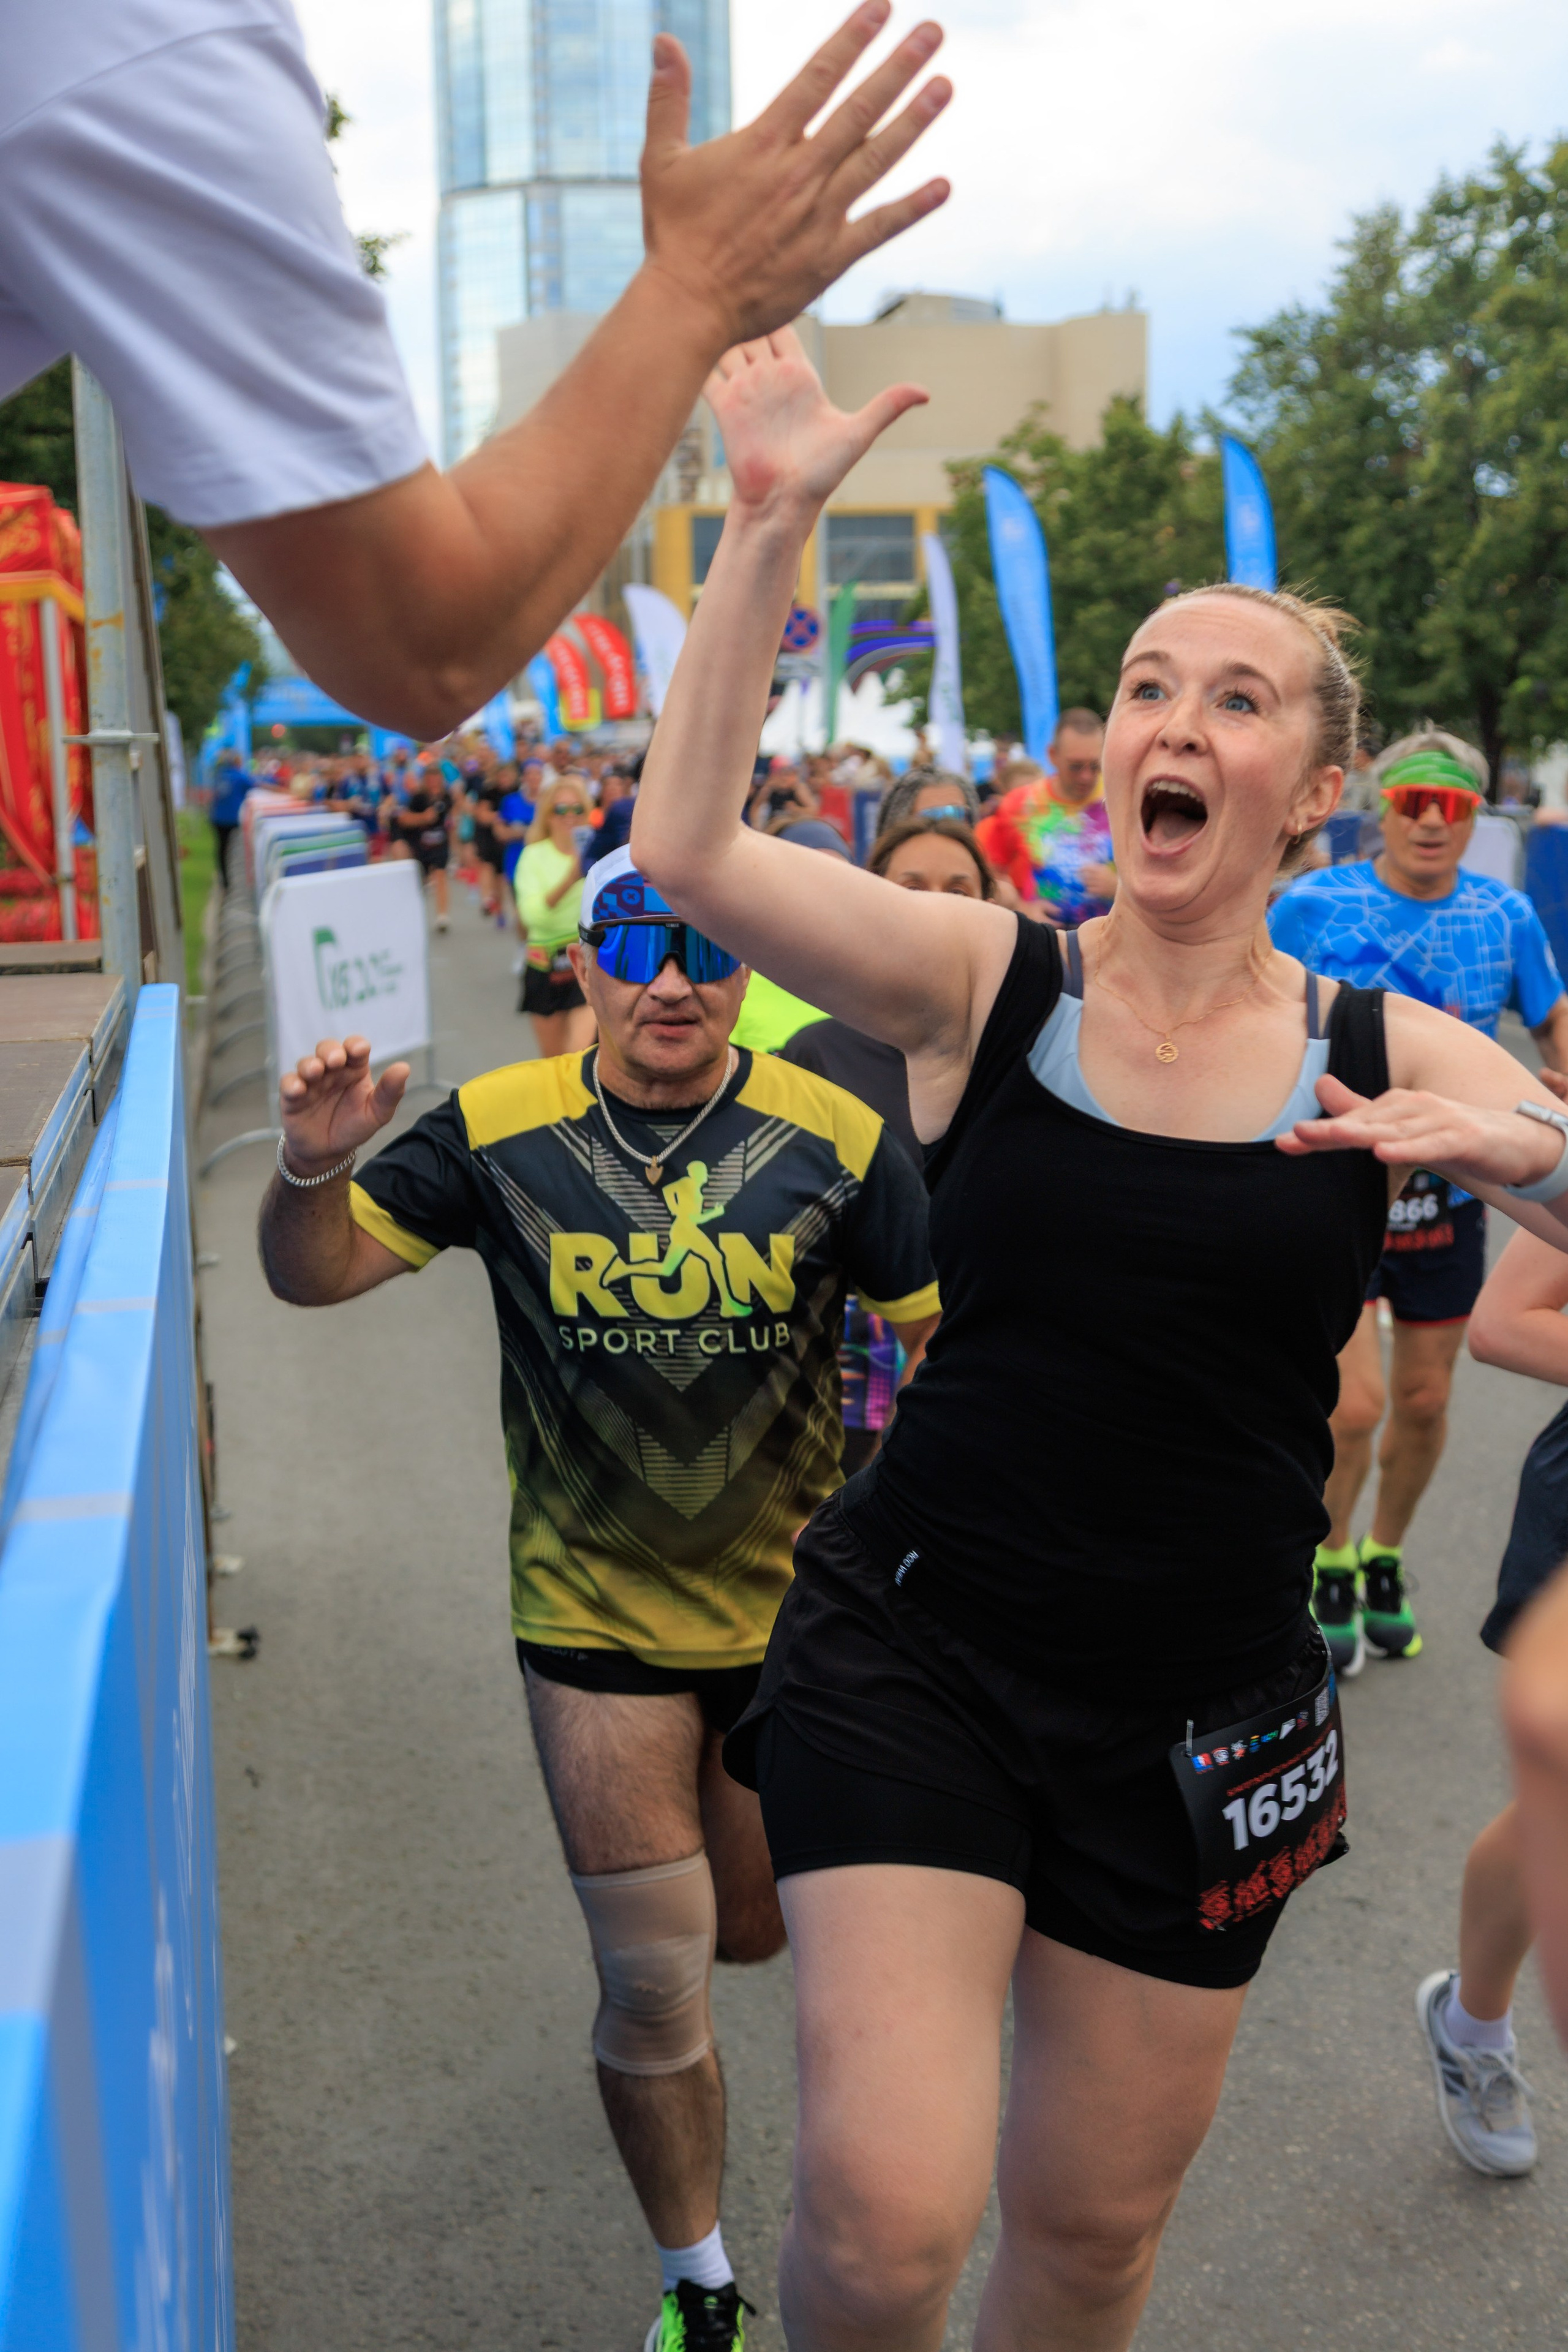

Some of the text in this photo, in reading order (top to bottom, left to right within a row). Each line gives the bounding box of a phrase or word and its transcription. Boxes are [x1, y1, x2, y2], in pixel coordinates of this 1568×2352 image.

[549, 1232, 796, 1319] RUN
[559, 1322, 791, 1354] SPORT CLUB
[1222, 1729, 1339, 1850] 16532
